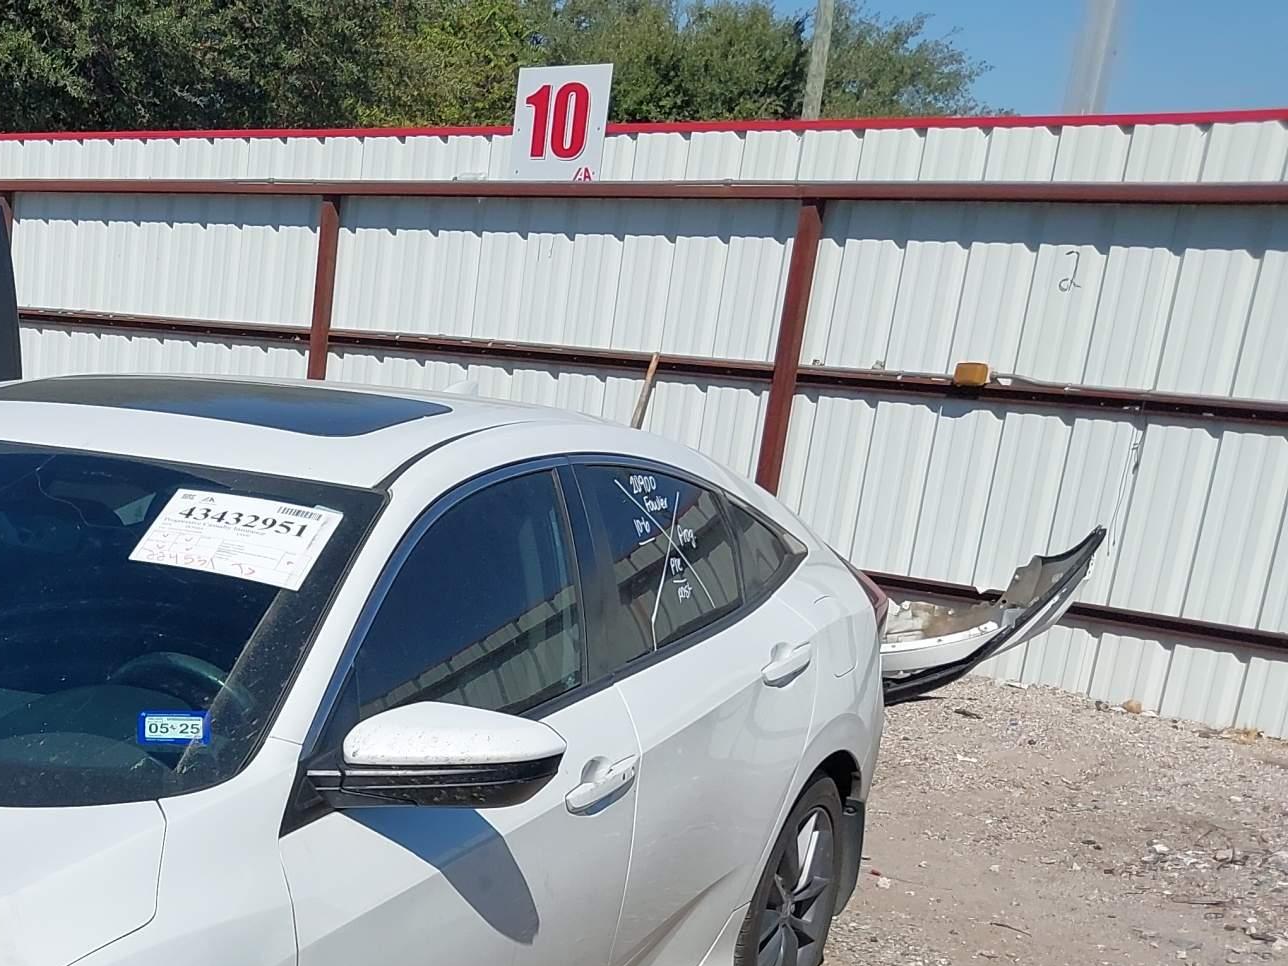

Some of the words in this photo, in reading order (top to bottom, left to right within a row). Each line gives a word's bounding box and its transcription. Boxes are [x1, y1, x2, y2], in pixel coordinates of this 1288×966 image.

[525, 81, 591, 160] 10
[178, 505, 309, 538] 43432951
[149, 723, 169, 734] 05
[179, 723, 200, 734] 25
